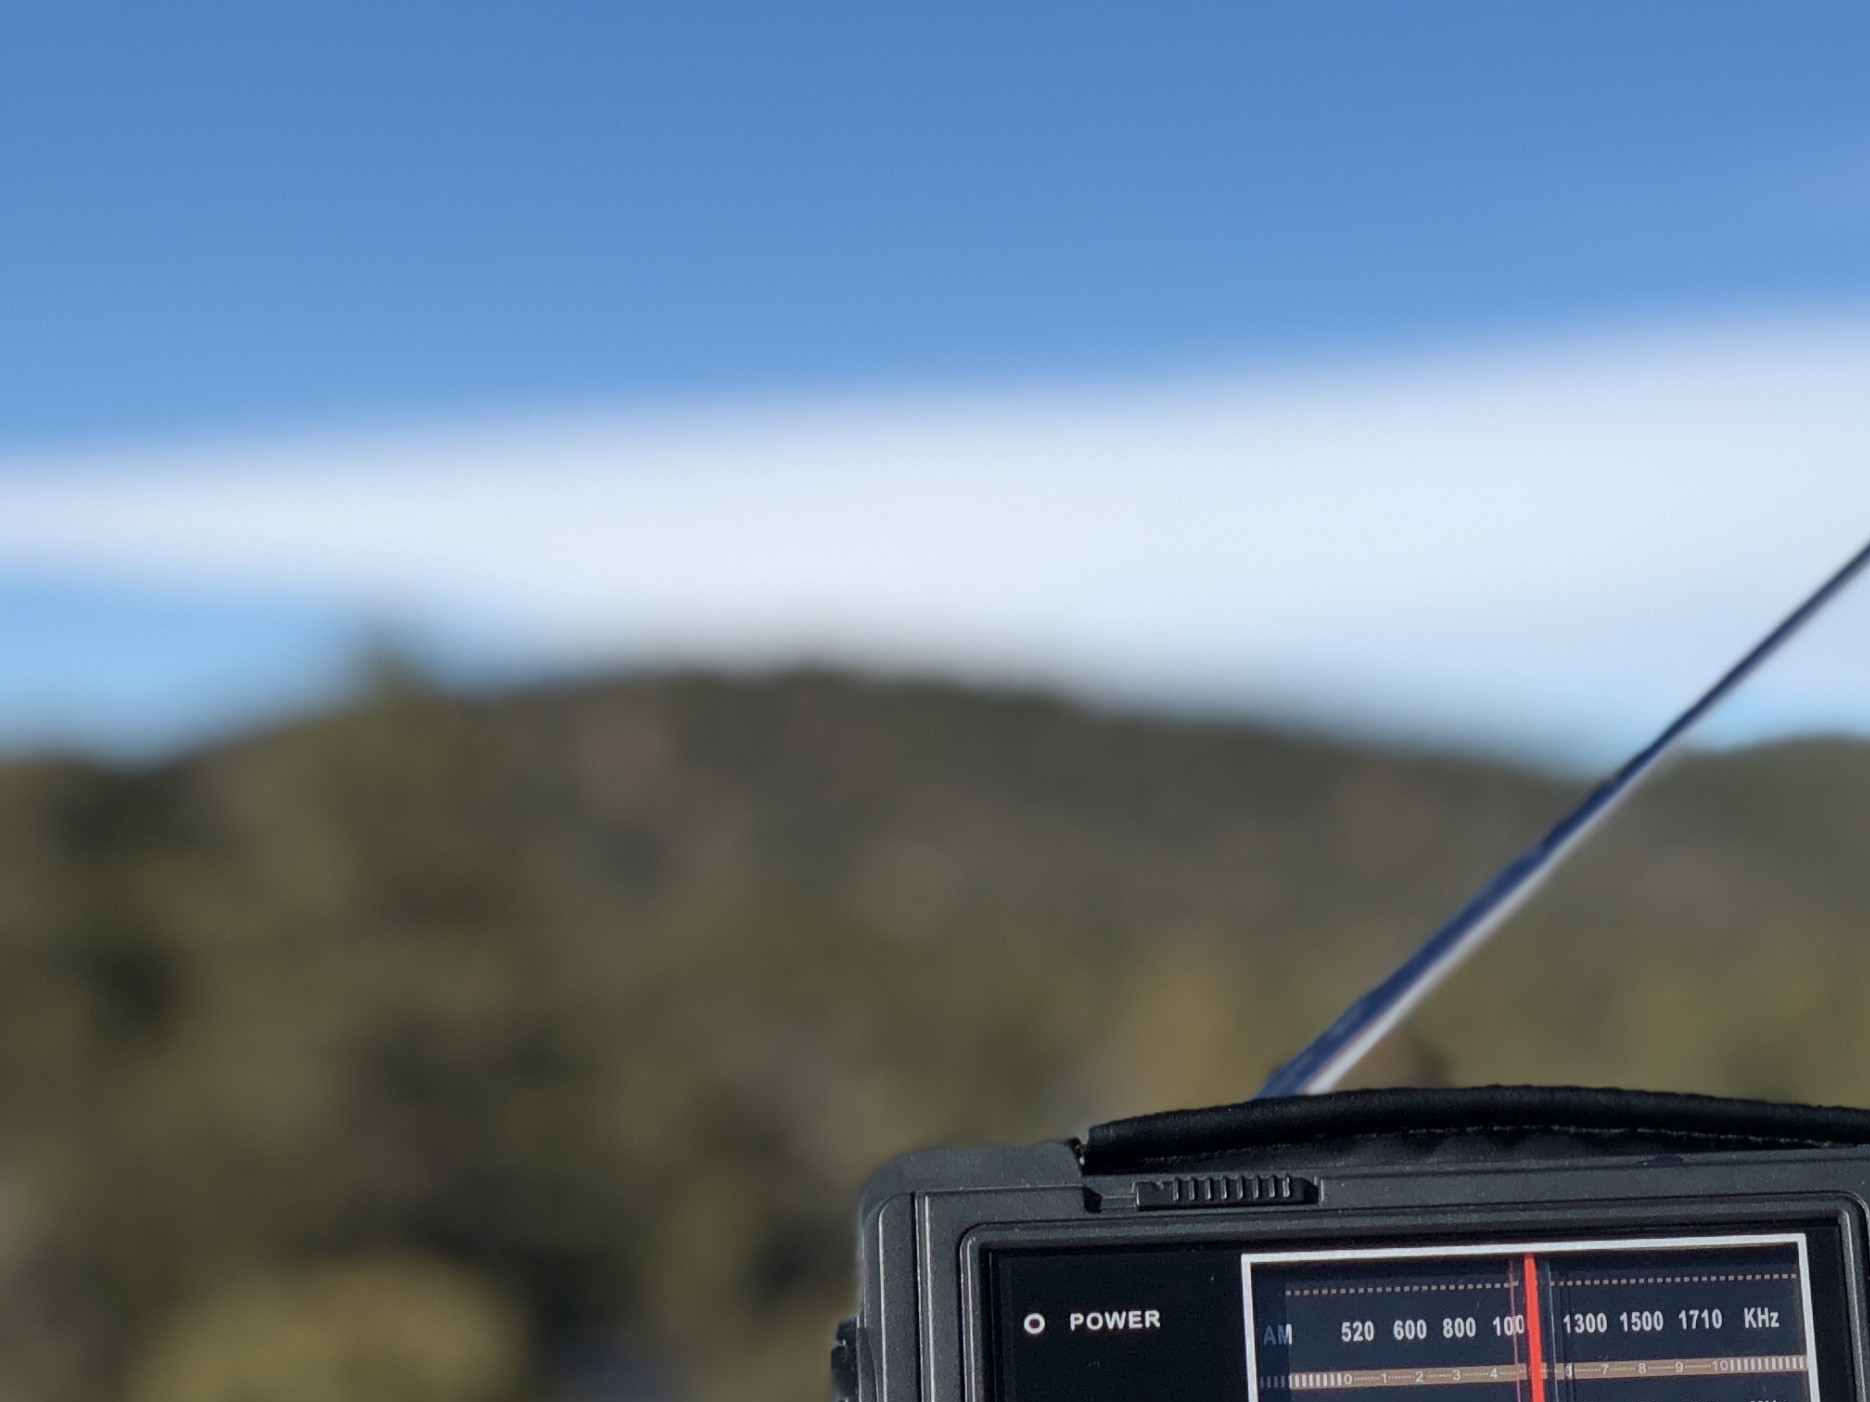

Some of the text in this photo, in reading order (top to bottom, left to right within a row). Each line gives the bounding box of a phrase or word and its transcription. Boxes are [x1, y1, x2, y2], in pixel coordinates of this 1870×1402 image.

[1070, 1310, 1160, 1331] POWER
[1263, 1307, 1779, 1345] AM 520 600 800 100 1300 1500 1710 KHz
